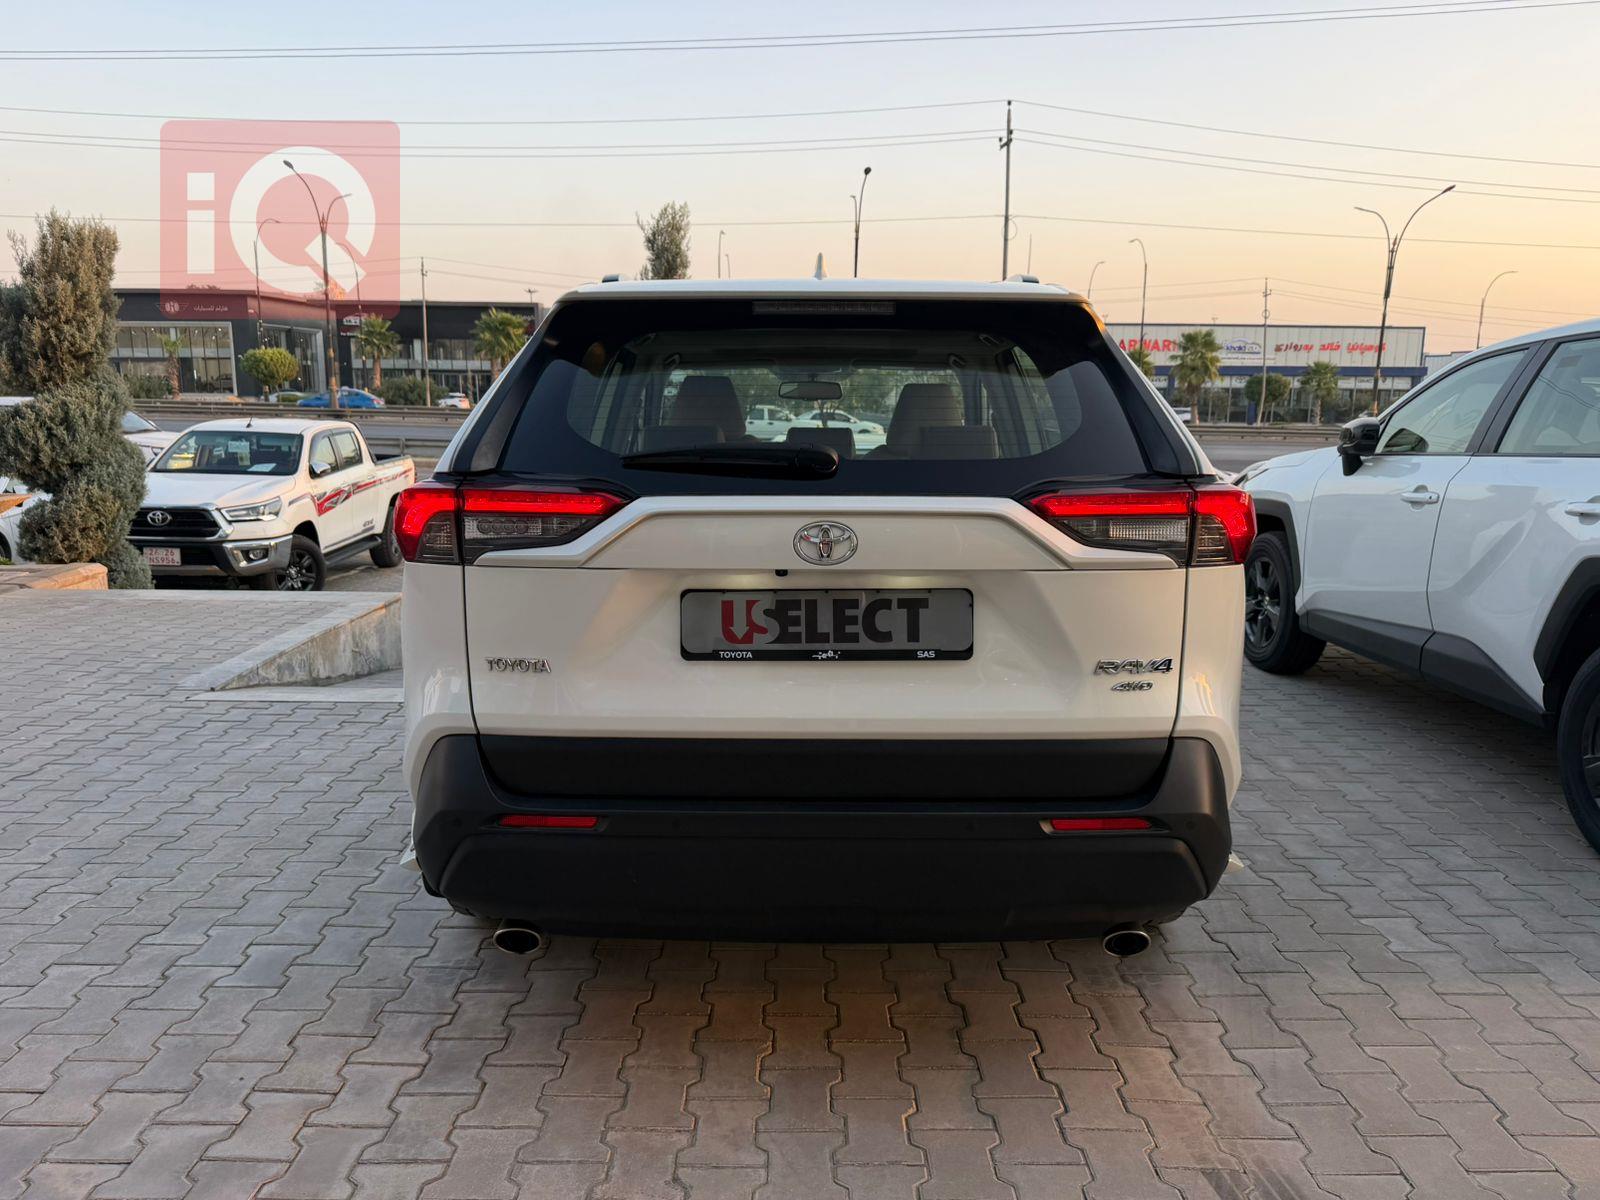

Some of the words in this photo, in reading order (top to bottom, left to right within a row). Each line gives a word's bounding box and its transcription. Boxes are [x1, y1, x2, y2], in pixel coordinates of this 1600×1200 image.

[1119, 339, 1178, 351] ARWARI
[719, 651, 752, 659] TOYOTA
[917, 651, 935, 659] SAS
[485, 657, 551, 673] TOYOTA
[1094, 657, 1173, 675] RAV4
